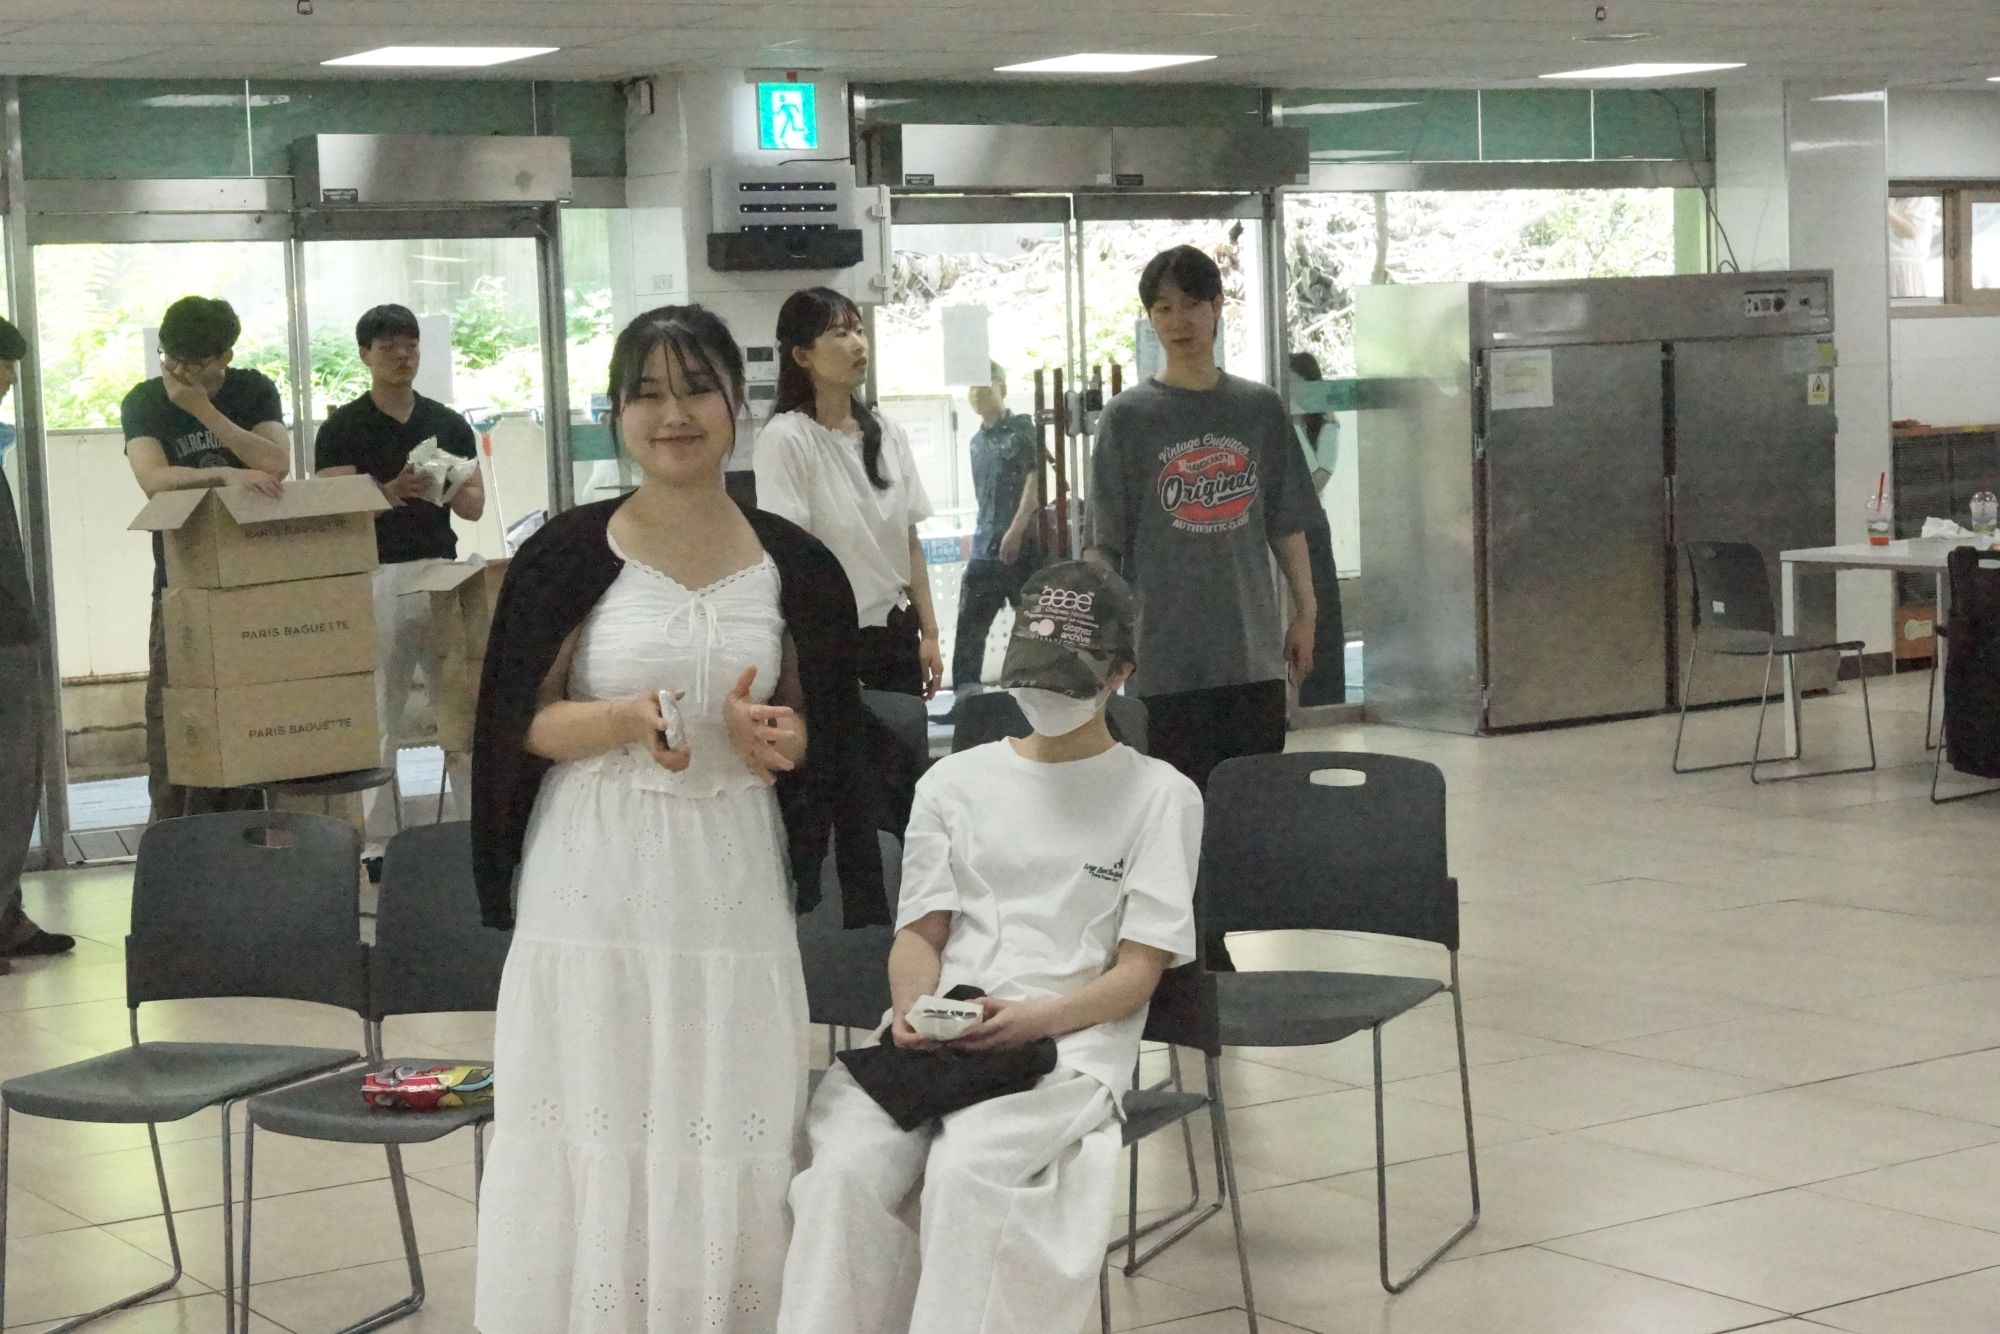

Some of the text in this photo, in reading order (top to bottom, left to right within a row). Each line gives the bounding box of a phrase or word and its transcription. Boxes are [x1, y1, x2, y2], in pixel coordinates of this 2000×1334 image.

[1159, 438, 1200, 463] Vintage
[1161, 461, 1257, 511] Original
[241, 619, 351, 640] PARIS BAGUETTE
[248, 725, 287, 738] PARIS
